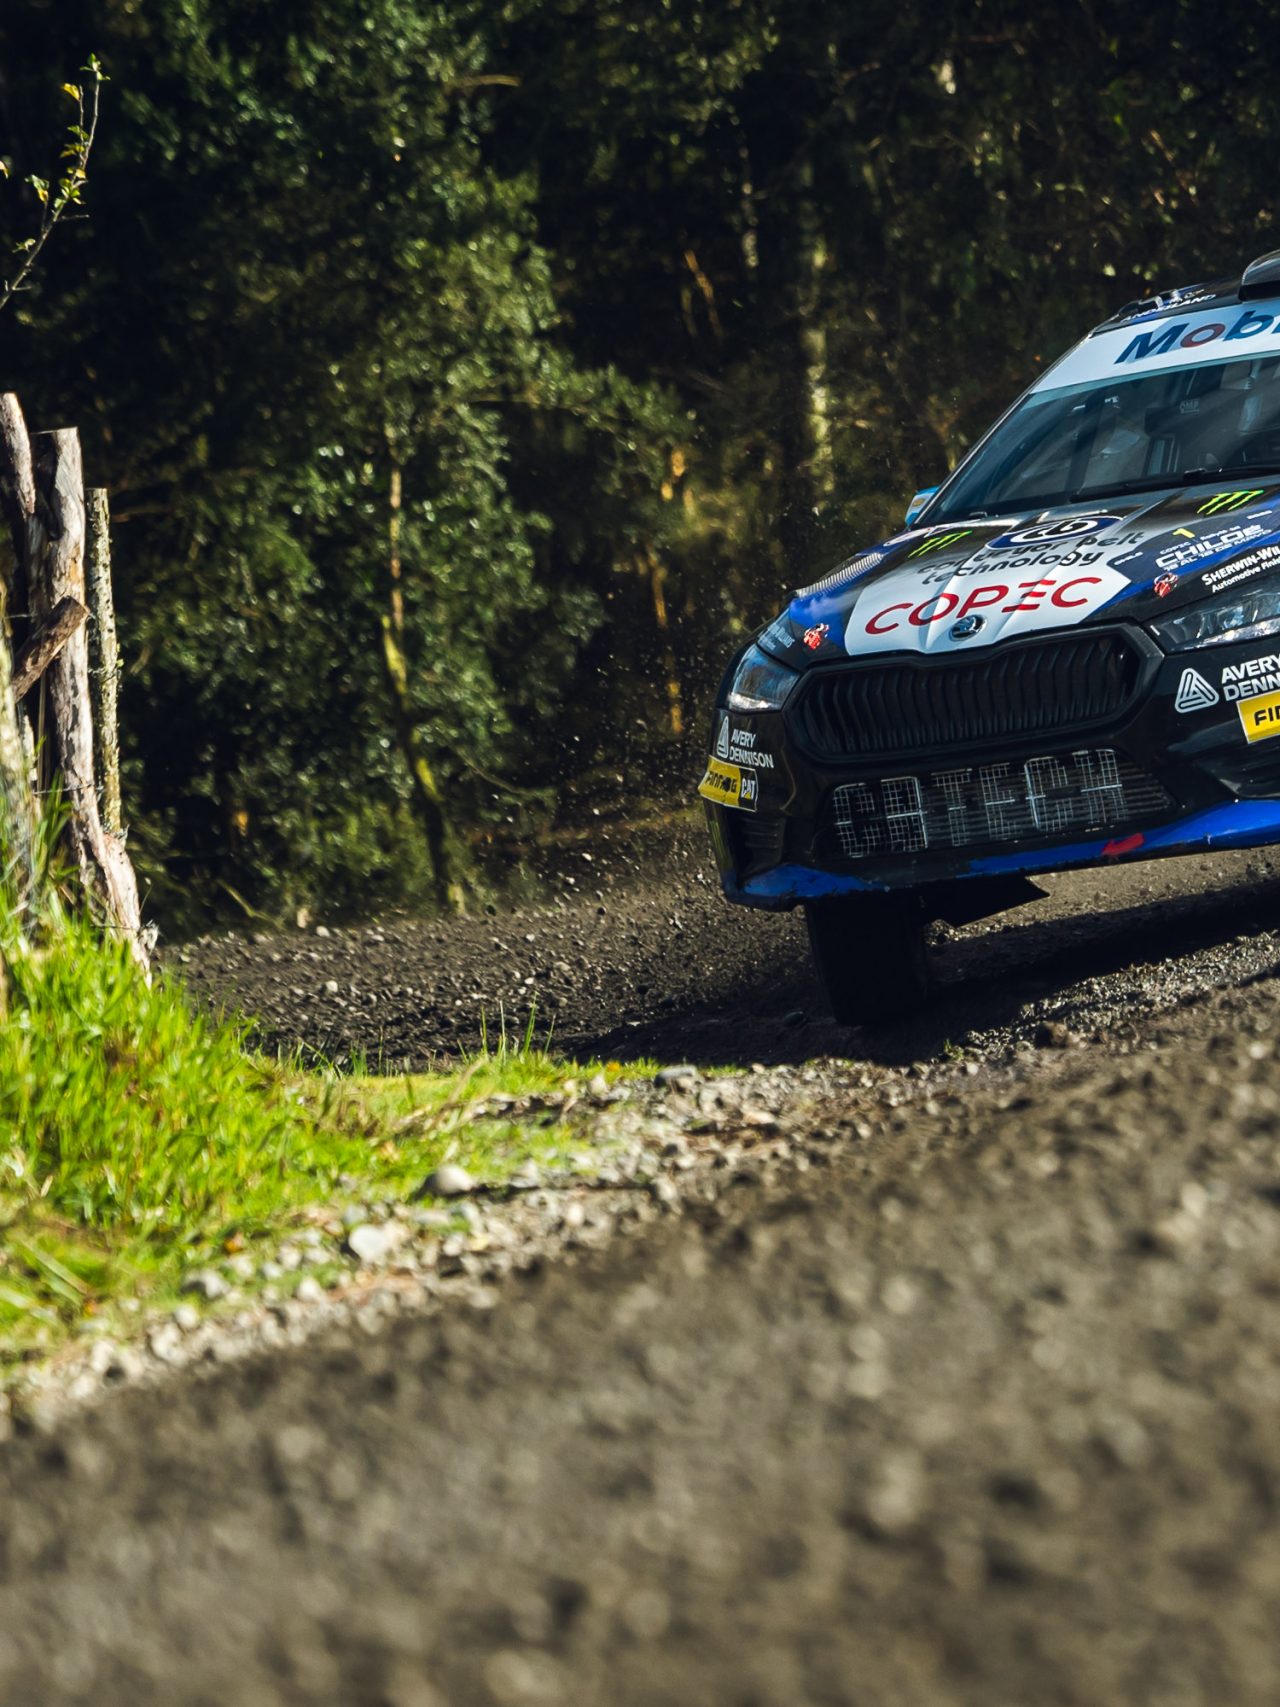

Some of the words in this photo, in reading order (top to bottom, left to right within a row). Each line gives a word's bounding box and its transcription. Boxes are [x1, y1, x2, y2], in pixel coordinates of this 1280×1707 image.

[1172, 528, 1196, 539] 1
[921, 549, 1105, 586] technology
[1211, 564, 1262, 593] Automotive
[864, 577, 1103, 635] COPEC
[731, 728, 756, 748] AVERY
[729, 746, 775, 769] DENNISON
[741, 777, 756, 799] CAT
